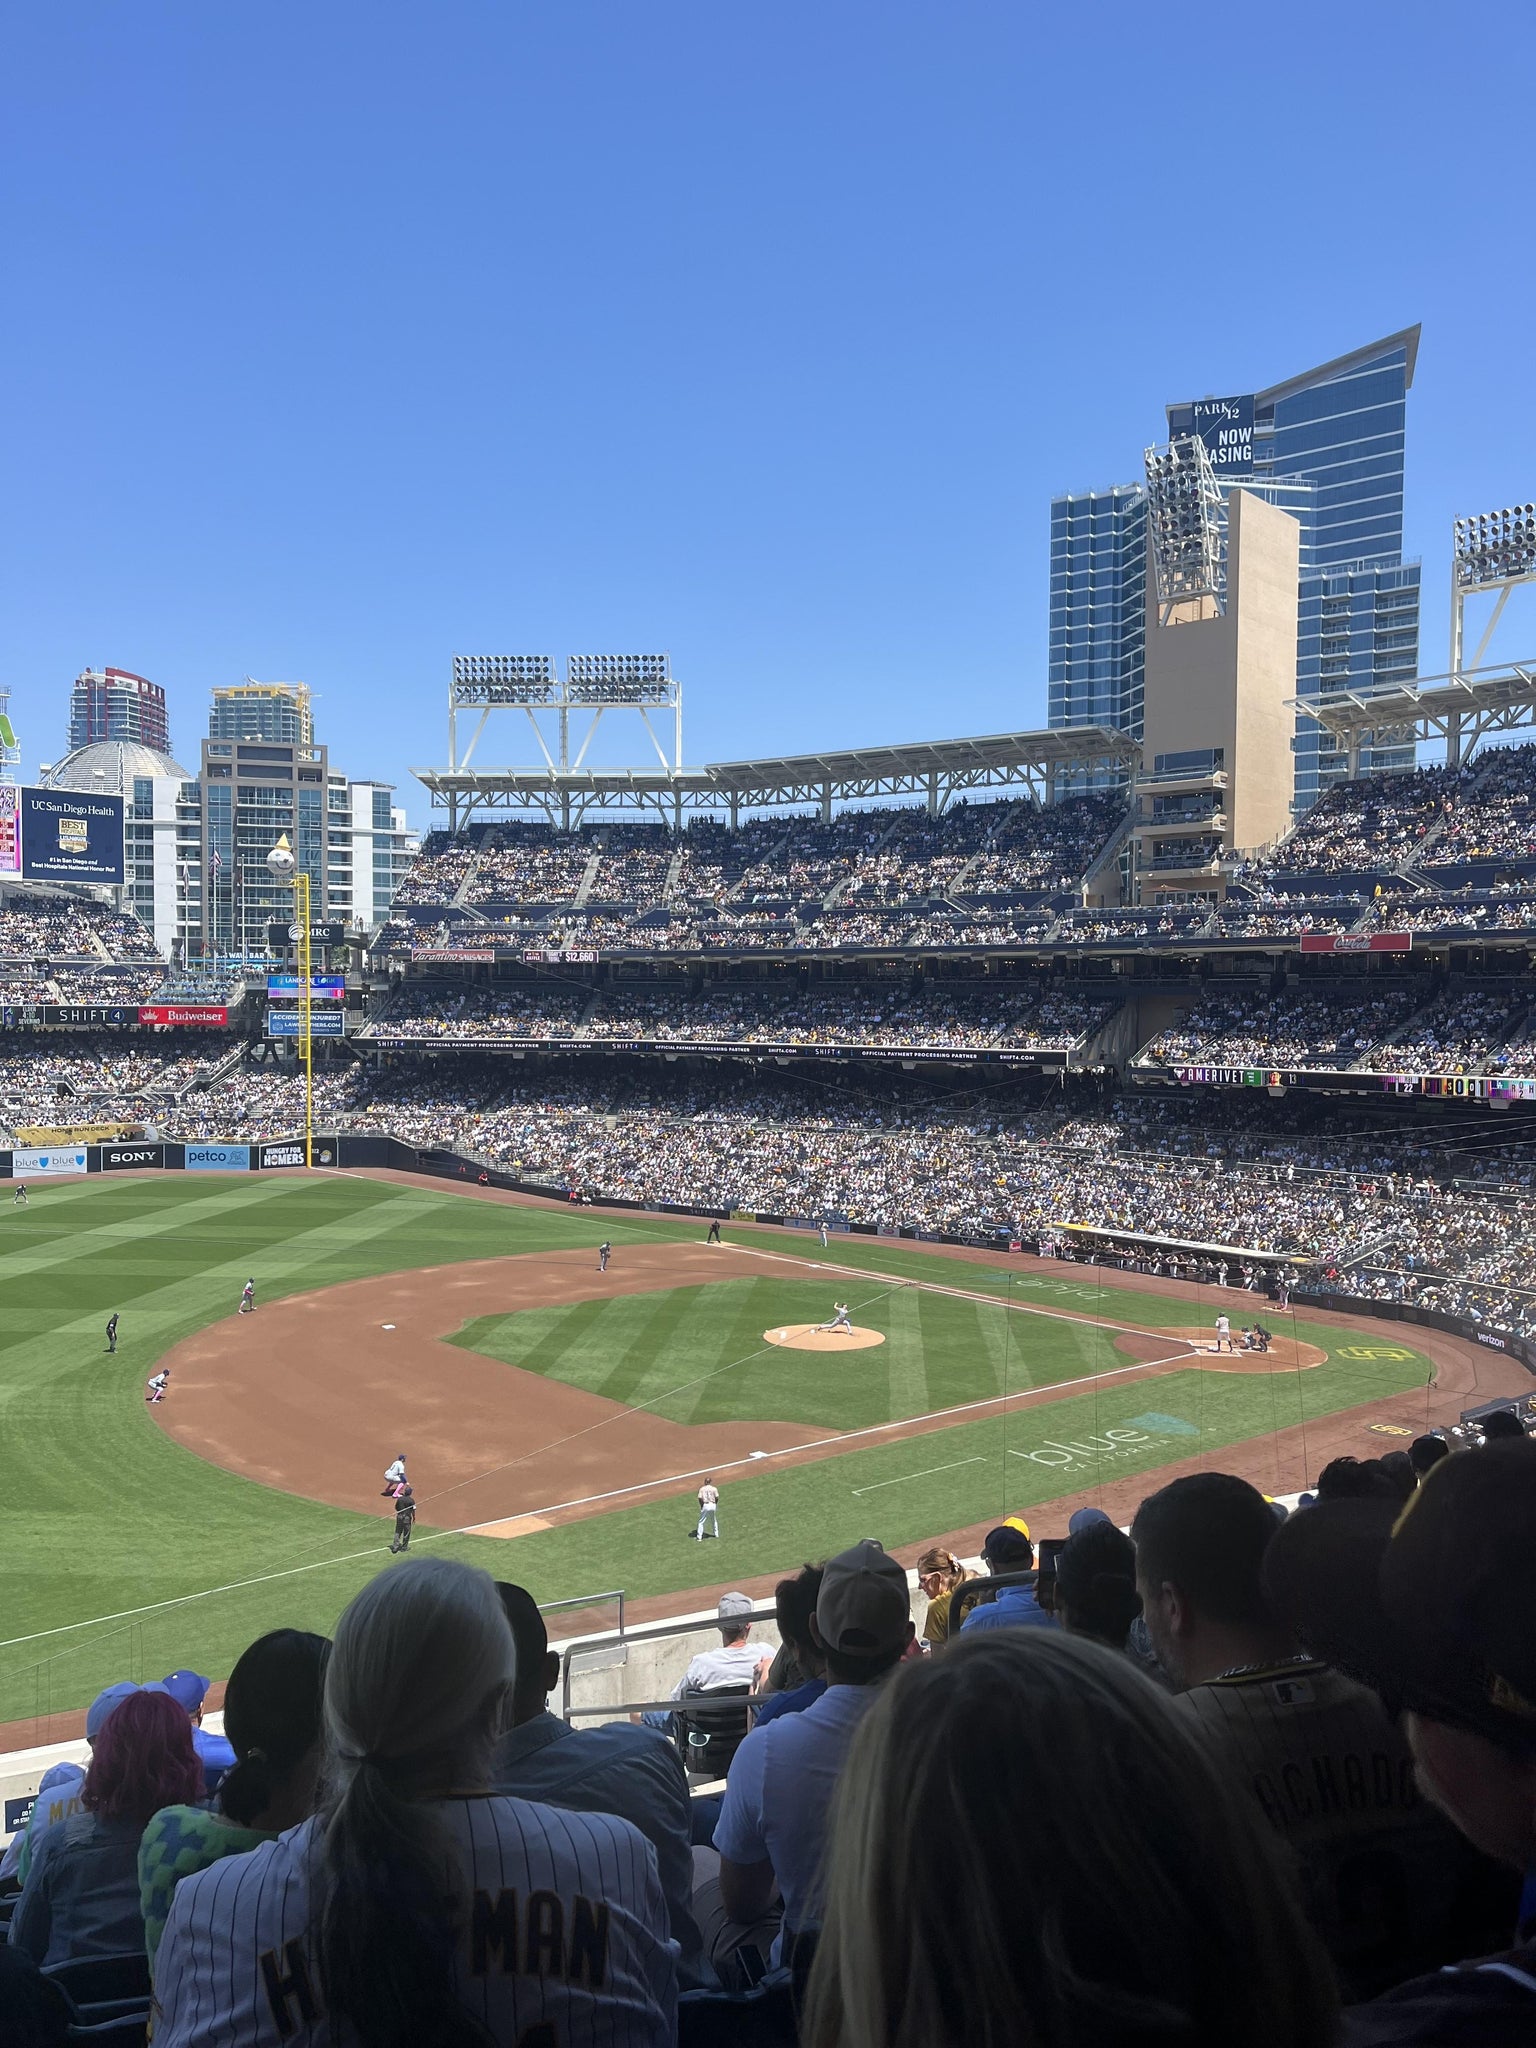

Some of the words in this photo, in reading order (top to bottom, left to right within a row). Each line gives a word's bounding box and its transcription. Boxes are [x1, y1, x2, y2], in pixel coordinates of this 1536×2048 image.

[1194, 402, 1230, 416] PARK
[1227, 408, 1240, 419] 12
[1219, 427, 1252, 446] NOW
[1206, 445, 1252, 464] ASING
[31, 800, 46, 810] UC
[46, 802, 62, 812] San
[63, 804, 87, 815] Diego
[88, 806, 114, 816] Health
[61, 820, 85, 829] BEST
[414, 951, 457, 961] Tarantino
[565, 951, 594, 962] $12,660
[167, 1010, 223, 1021] Budweiser
[1188, 1068, 1244, 1083] AMERIVET
[1403, 1083, 1413, 1093] 22
[1528, 1084, 1534, 1094] H
[290, 1146, 302, 1154] FOR
[15, 1158, 39, 1167] blue
[52, 1156, 75, 1165] blue
[110, 1151, 156, 1163] SONY
[188, 1150, 227, 1163] petco
[263, 1153, 305, 1166] HOMERS
[1477, 1332, 1505, 1348] verizon
[1007, 1429, 1150, 1466] blue
[1063, 1438, 1173, 1473] CALIFORNIA
